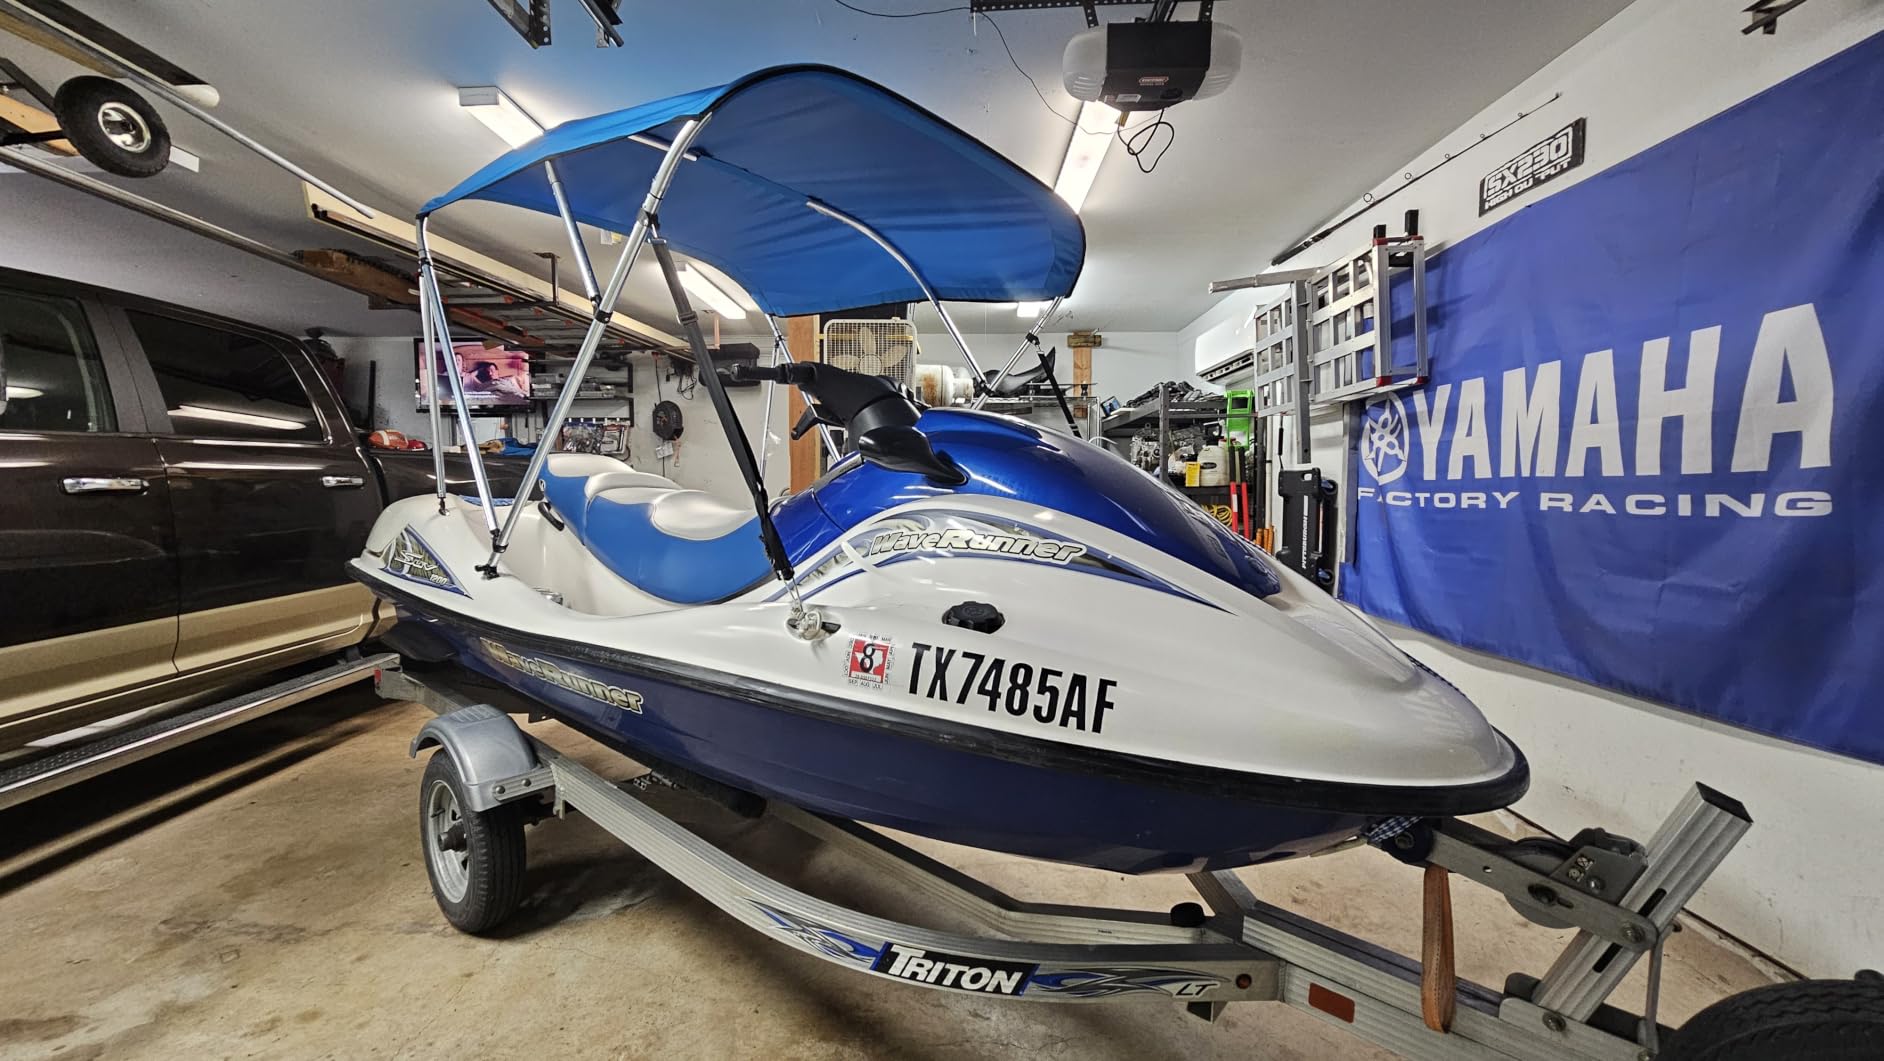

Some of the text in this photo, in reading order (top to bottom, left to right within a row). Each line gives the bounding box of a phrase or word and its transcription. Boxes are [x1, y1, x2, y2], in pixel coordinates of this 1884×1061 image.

[1487, 135, 1568, 196] SX230
[1485, 189, 1513, 210] HIGH
[1413, 302, 1834, 480] YAMAHA
[1357, 487, 1833, 517] FCTORY RACING
[870, 528, 1082, 562] WaveRunner
[430, 574, 448, 584] 1200
[860, 643, 875, 673] 8
[909, 642, 1118, 734] TX7485AF
[888, 944, 1023, 994] TRITON
[1176, 983, 1218, 996] LT
